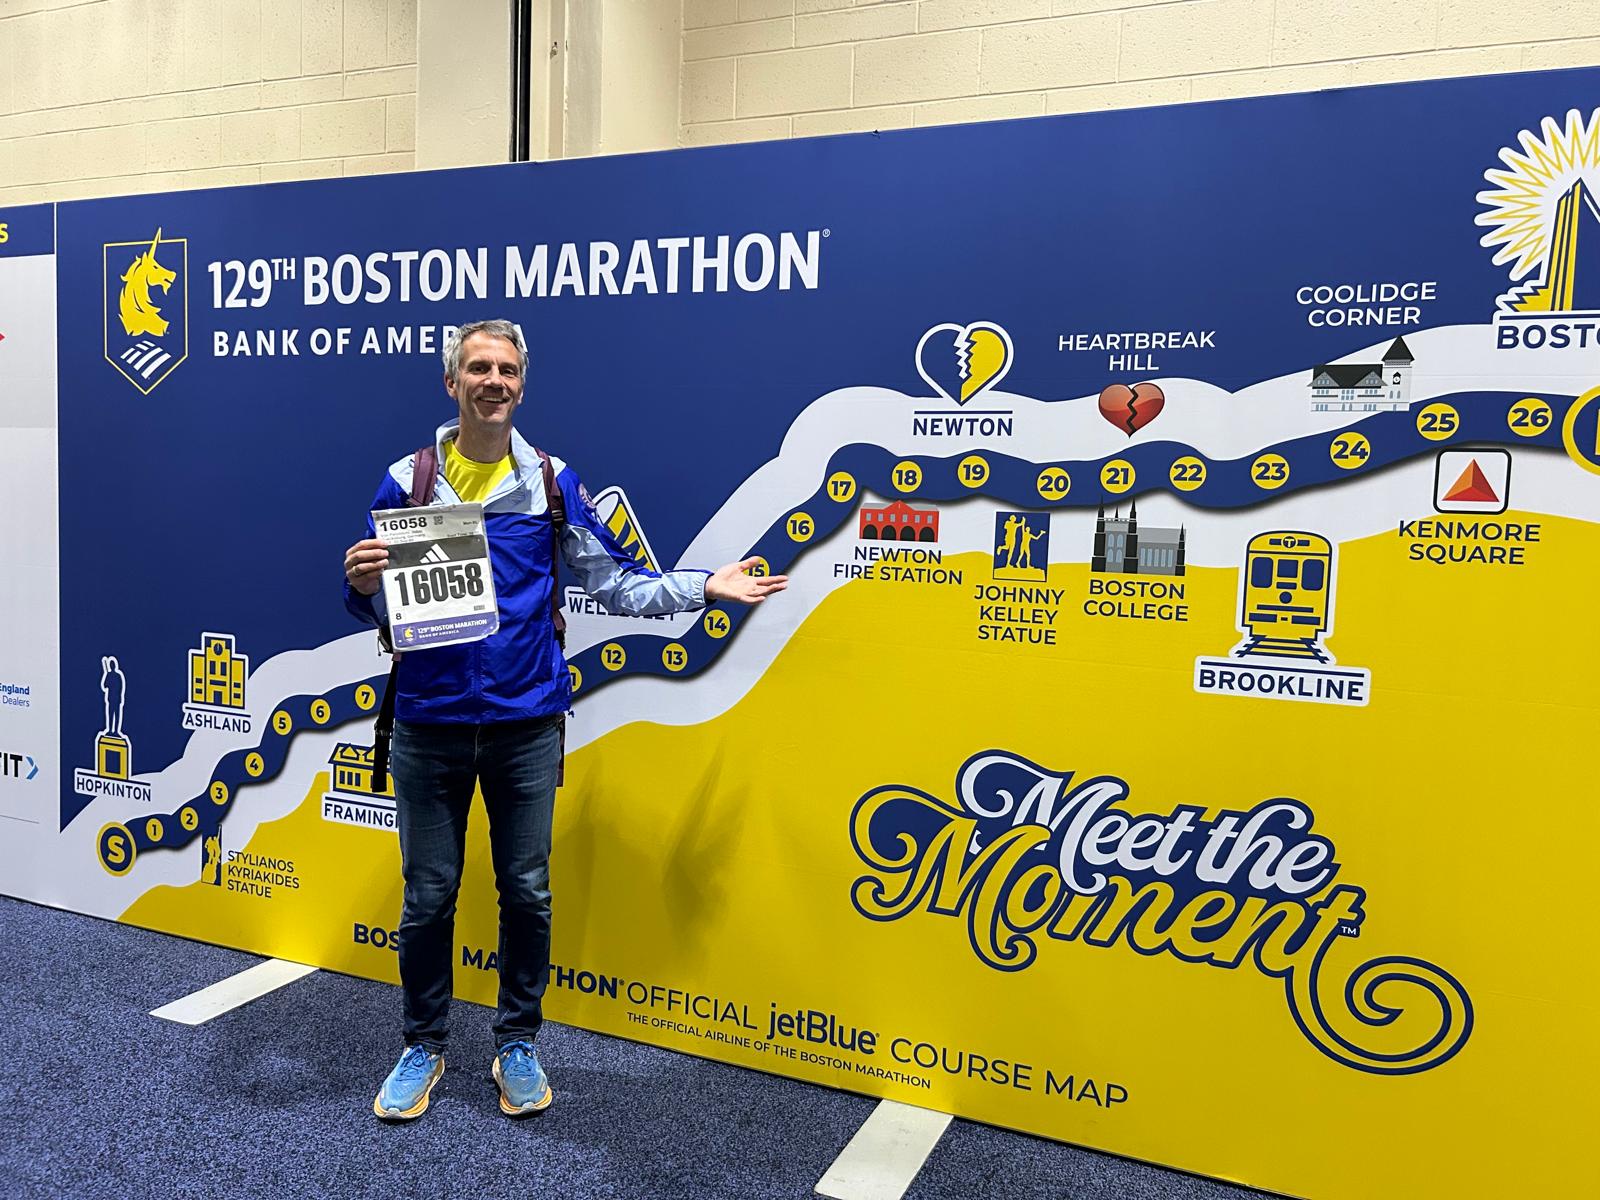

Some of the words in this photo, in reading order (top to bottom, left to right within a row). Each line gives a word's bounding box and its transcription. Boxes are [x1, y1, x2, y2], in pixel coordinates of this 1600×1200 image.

[208, 257, 296, 308] 129TH
[304, 247, 488, 306] BOSTON
[1296, 281, 1437, 305] COOLIDGE
[1308, 306, 1421, 328] CORNER
[213, 329, 300, 357] BANK
[310, 327, 352, 355] OF
[1058, 331, 1216, 352] HEARTBREAK
[1497, 323, 1600, 350] BOST
[1108, 354, 1160, 371] HILL
[913, 417, 1014, 436] NEWTON
[1420, 413, 1456, 432] 25
[1511, 407, 1550, 427] 26
[1333, 440, 1368, 460] 24
[895, 470, 918, 486] 18
[962, 463, 985, 480] 19
[1105, 468, 1130, 485] 21
[1174, 464, 1203, 481] 22
[1255, 462, 1287, 480] 23
[831, 480, 852, 496] 17
[1040, 475, 1069, 492] 20
[380, 516, 428, 532] 16058
[790, 519, 811, 535] 16
[1399, 520, 1541, 542] KENMORE
[854, 546, 942, 565] NEWTON
[1409, 543, 1525, 565] SQUARE
[834, 563, 876, 580] FIRE
[880, 566, 963, 585] STATION
[394, 562, 484, 607] 16058
[1089, 579, 1185, 600] BOSTON
[974, 584, 1065, 605] JOHNNY
[395, 612, 402, 620] 8
[979, 605, 1058, 625] KELLEY
[1083, 600, 1189, 622] COLLEGE
[430, 623, 454, 632] BOSTON
[455, 619, 488, 628] MARATHON
[707, 616, 727, 632] 14
[978, 624, 1056, 645] STATUE
[605, 650, 622, 664] 12
[666, 650, 683, 665] 13
[1199, 669, 1365, 701] BROOKLINE
[2, 695, 30, 708] Dealers
[361, 690, 371, 704] 7
[315, 705, 325, 718] 6
[184, 714, 251, 733] ASHLAND
[278, 716, 287, 730] 5
[249, 757, 260, 771] 4
[76, 776, 152, 802] HOPKINTON
[214, 786, 224, 799] 3
[185, 812, 194, 826] 2
[324, 802, 398, 829] FRAMING
[961, 755, 1196, 895] Meet
[1209, 803, 1329, 893] the
[151, 823, 158, 836] 1
[107, 834, 125, 863] S
[227, 850, 294, 873] STYLIANOS
[227, 866, 300, 889] KYRIAKIDES
[227, 879, 272, 898] STATUE
[627, 981, 758, 1031] OFFICIAL
[891, 1037, 1033, 1091] COURSE
[1045, 1069, 1129, 1109] MAP
[627, 1011, 648, 1025] THE
[651, 1017, 702, 1037] OFFICIAL
[704, 1030, 751, 1049] AIRLINE
[753, 1040, 771, 1052] OF
[773, 1044, 797, 1059] THE
[800, 1051, 853, 1072] BOSTON
[854, 1063, 931, 1090] MARATHON
